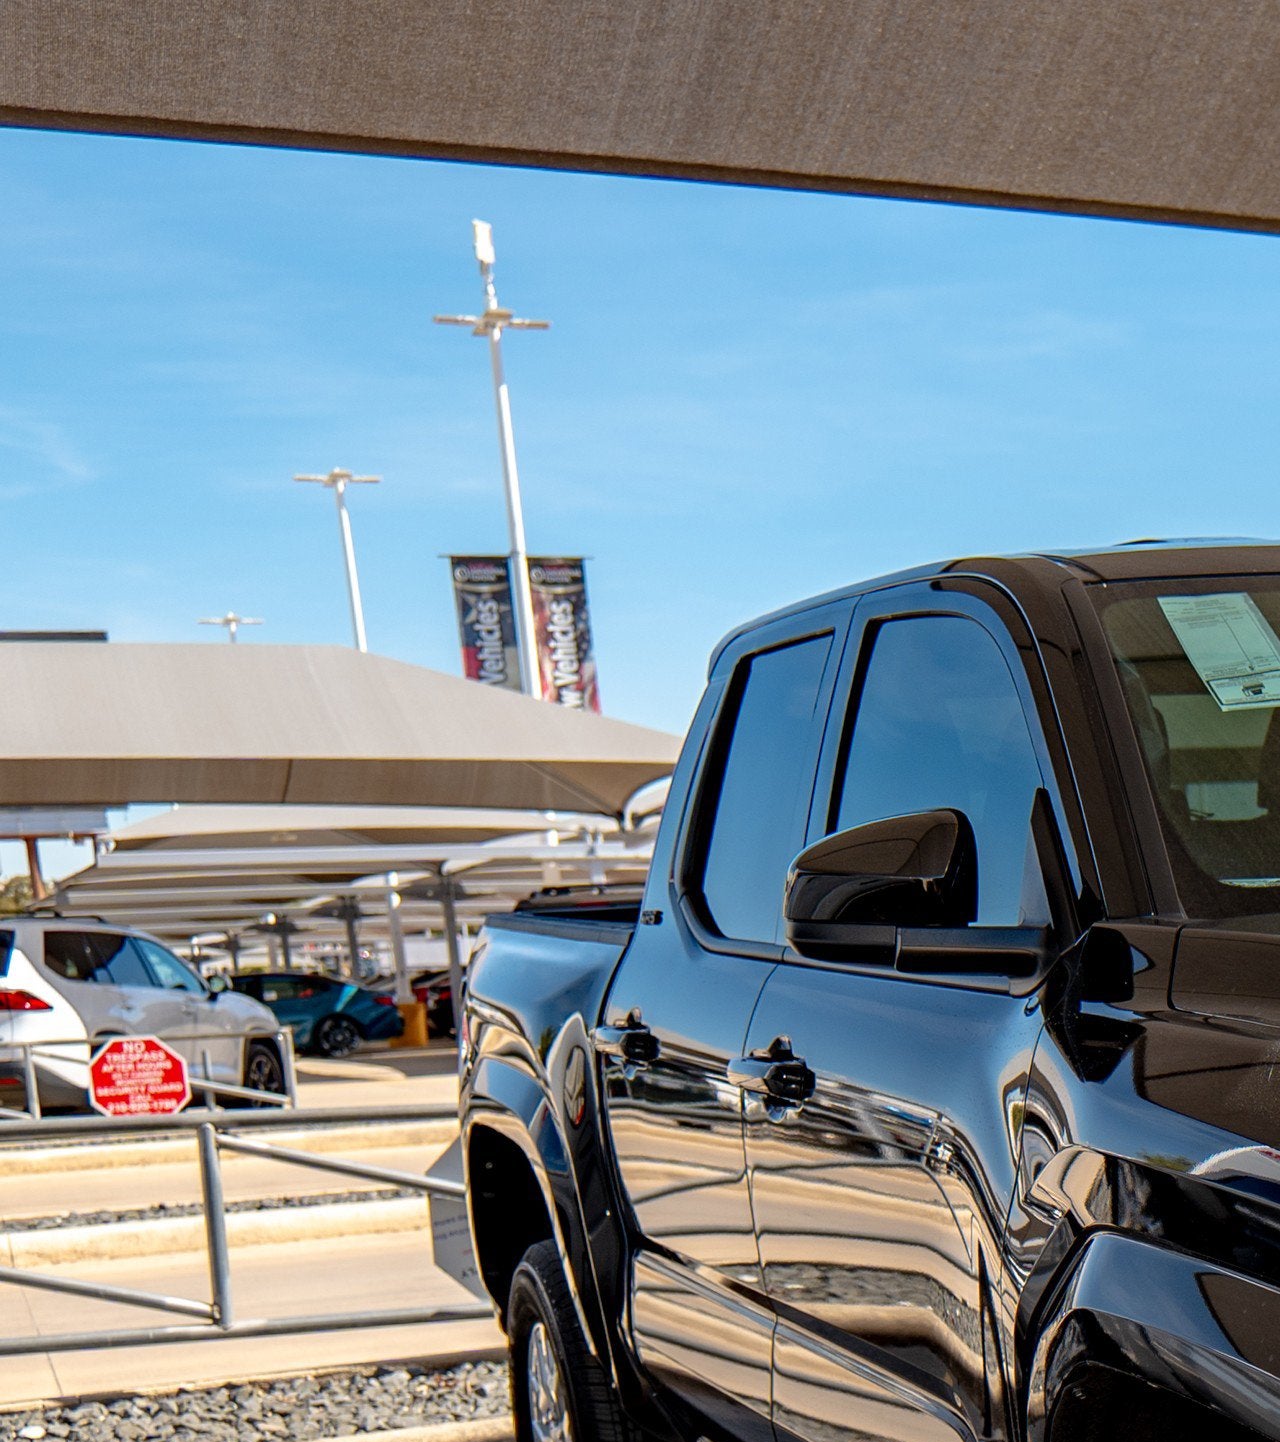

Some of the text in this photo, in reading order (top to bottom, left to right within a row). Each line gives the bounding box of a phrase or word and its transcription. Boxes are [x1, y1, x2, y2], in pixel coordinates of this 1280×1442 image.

[473, 598, 507, 684] Vehicles
[547, 600, 582, 686] Vehicles
[122, 1040, 146, 1053] NO
[106, 1050, 166, 1064] TRESPASS
[102, 1059, 172, 1073] AFTER HOURS
